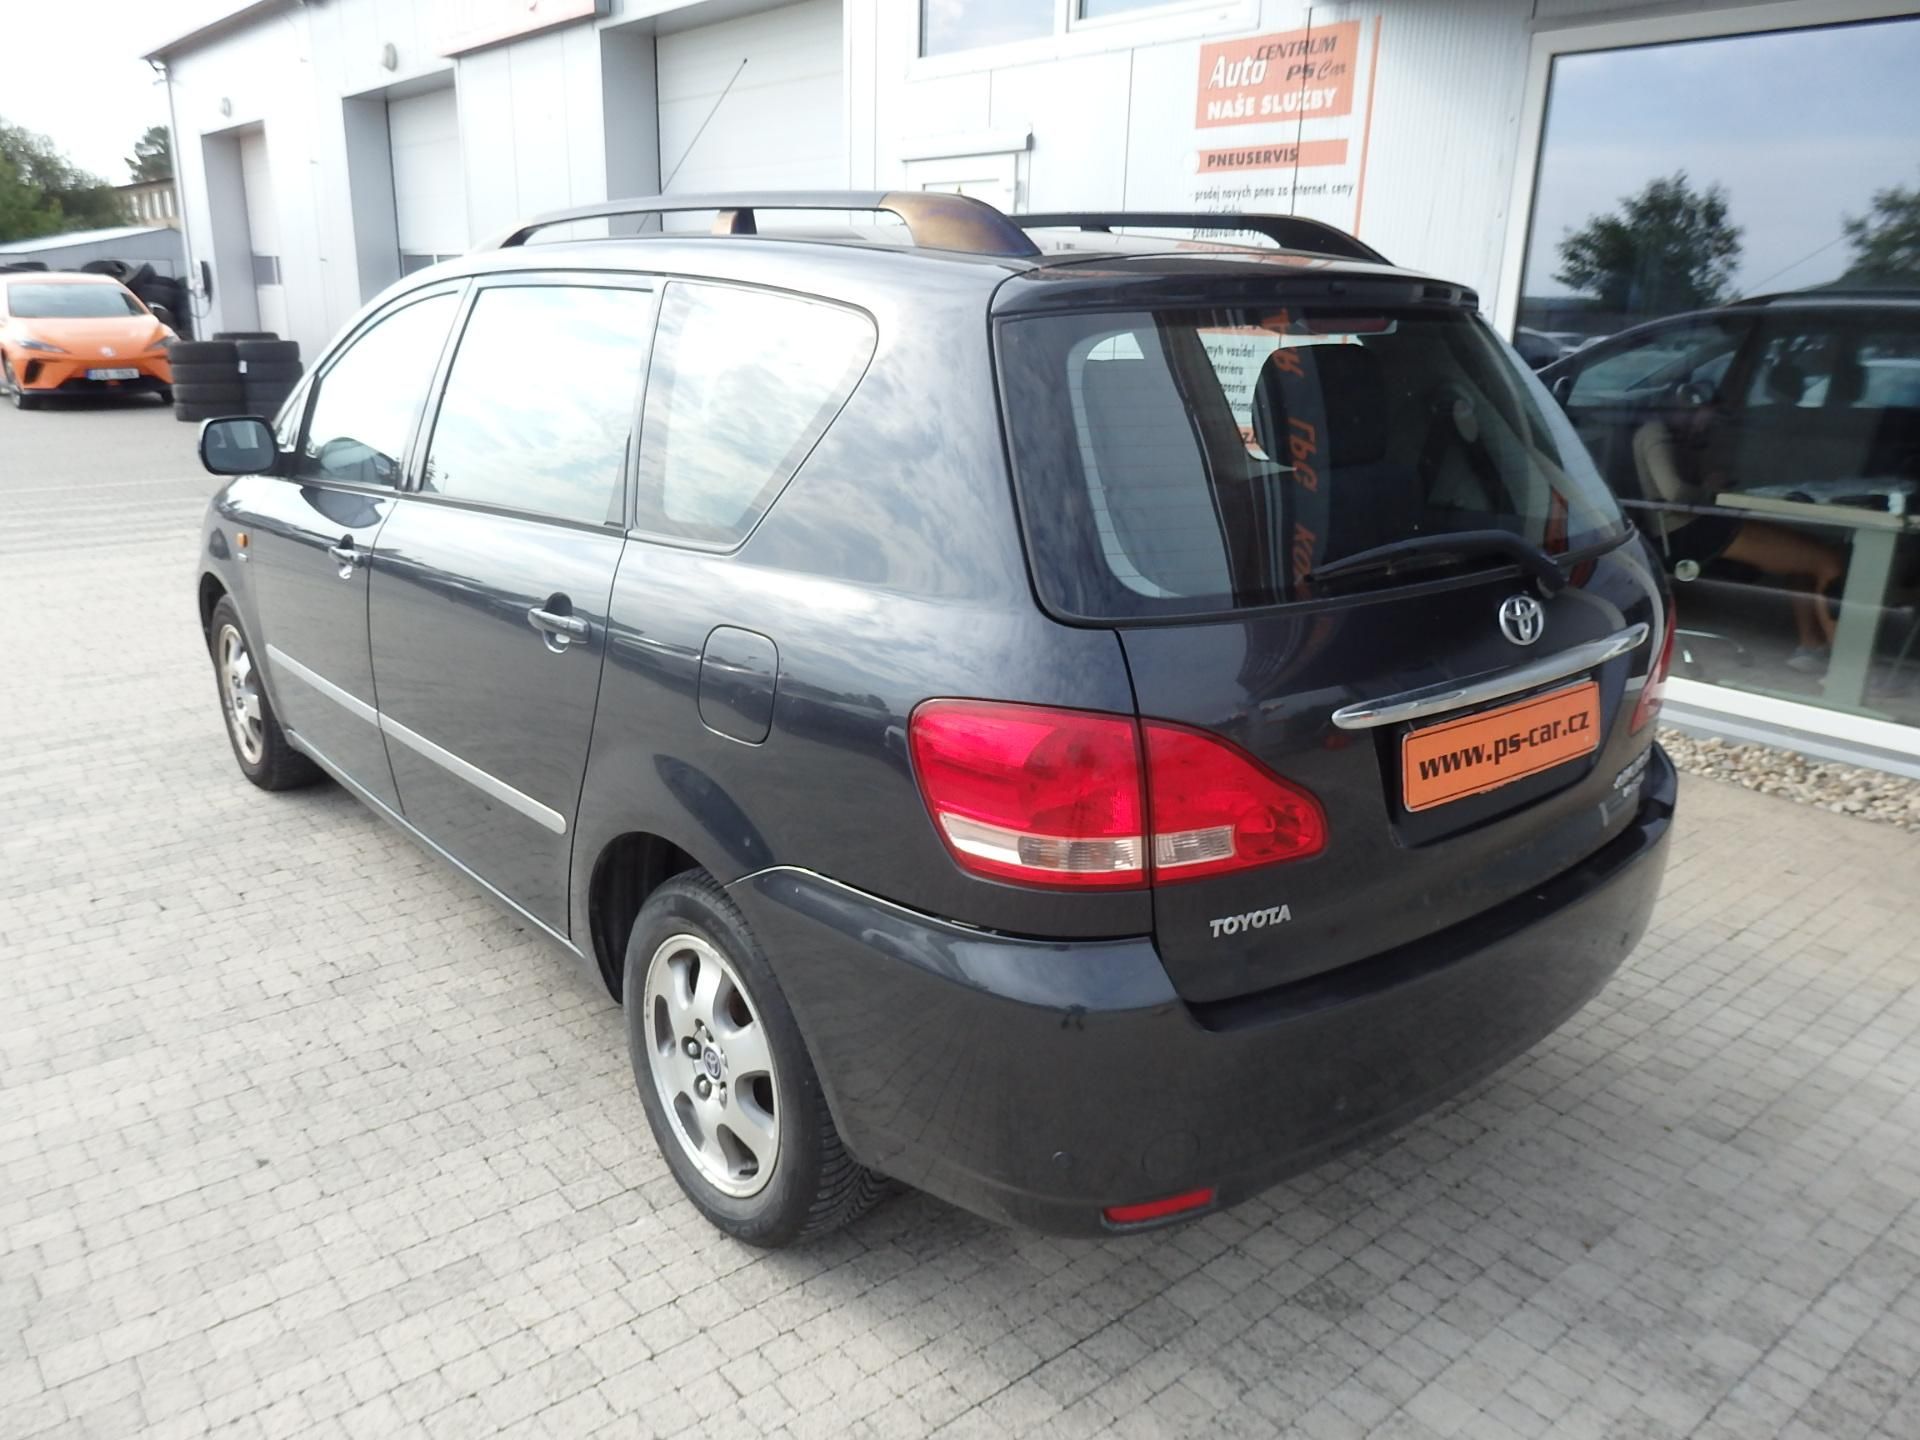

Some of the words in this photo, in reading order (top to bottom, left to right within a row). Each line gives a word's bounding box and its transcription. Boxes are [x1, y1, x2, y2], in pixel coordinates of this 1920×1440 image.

[1257, 36, 1338, 61] CENTRUM
[1208, 55, 1267, 90] Auto
[1286, 62, 1315, 81] PS
[1317, 60, 1346, 80] Car
[1207, 93, 1255, 120] NAŠE
[1260, 85, 1337, 115] SLUŽBY
[1207, 148, 1298, 167] PNEUSERVIS
[1195, 185, 1220, 202] prodej
[1254, 186, 1275, 200] pneu
[1332, 184, 1354, 199] ceny
[1418, 709, 1590, 781] www.ps-car.cz
[1210, 904, 1292, 938] TOYOTA
